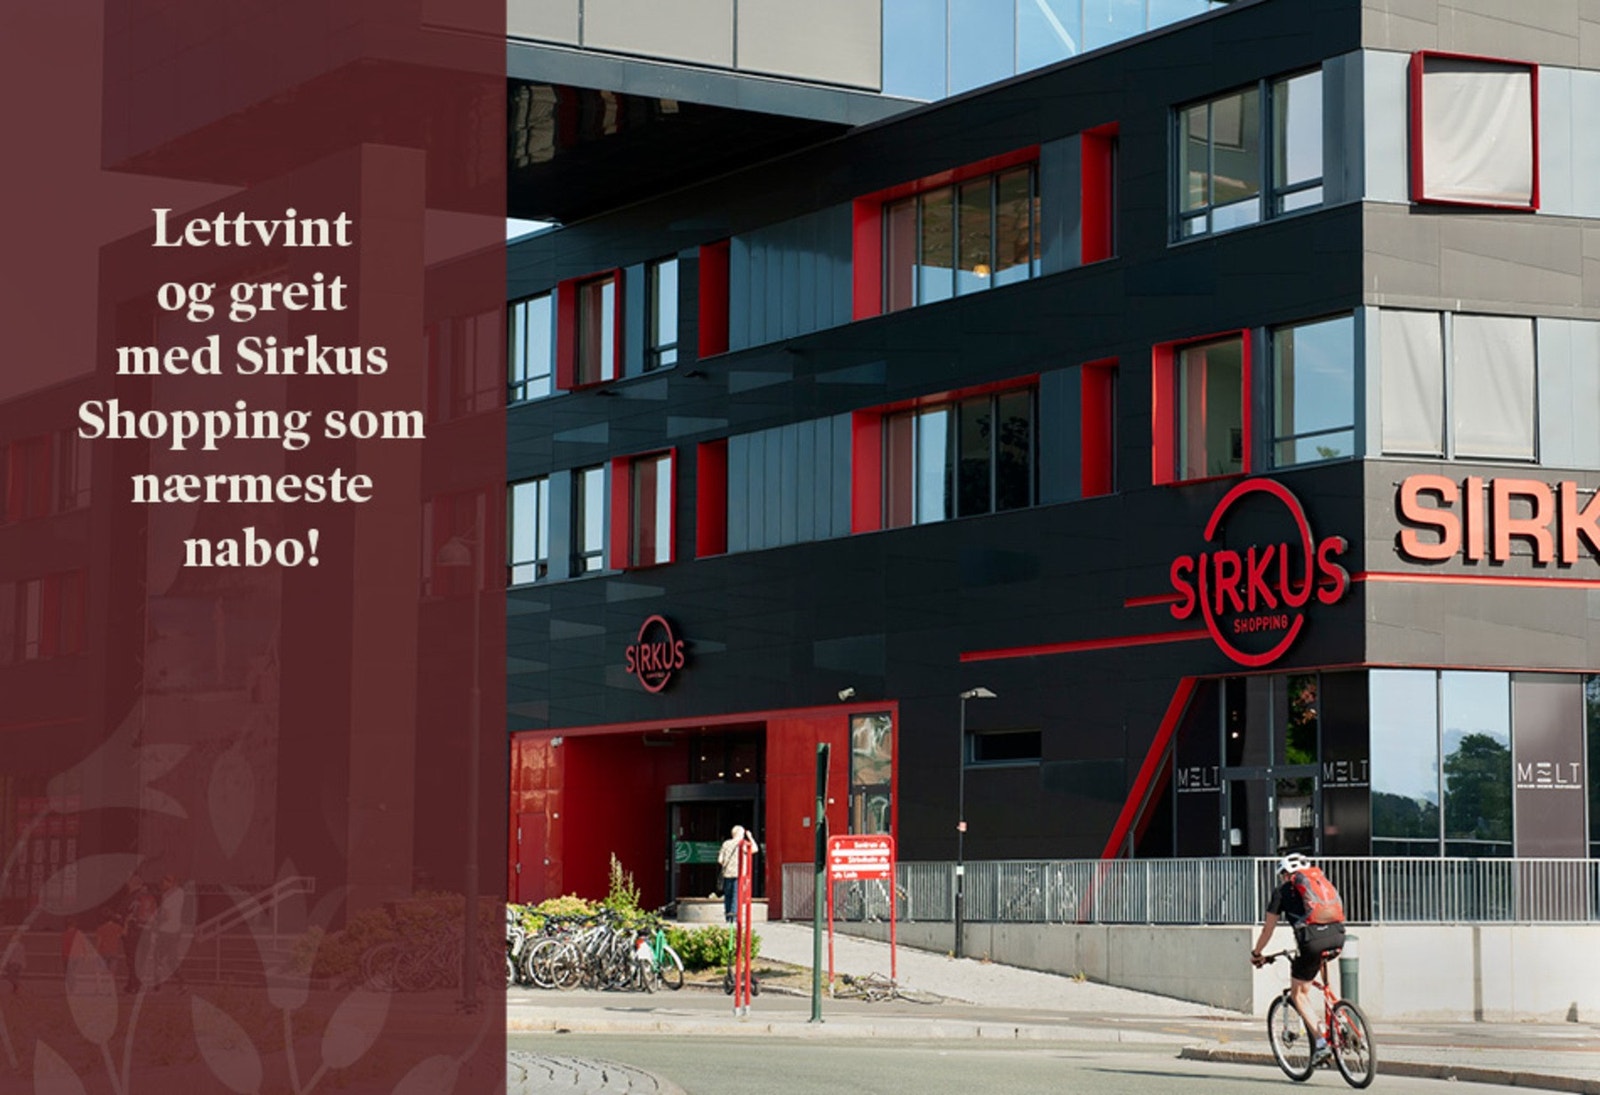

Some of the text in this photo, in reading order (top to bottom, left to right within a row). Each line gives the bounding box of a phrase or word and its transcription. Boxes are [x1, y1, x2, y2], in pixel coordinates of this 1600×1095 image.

[1401, 474, 1600, 563] SIRK
[1170, 535, 1349, 620] SIRKUS
[1233, 614, 1289, 634] SHOPPING
[625, 640, 685, 674] SIRKUS
